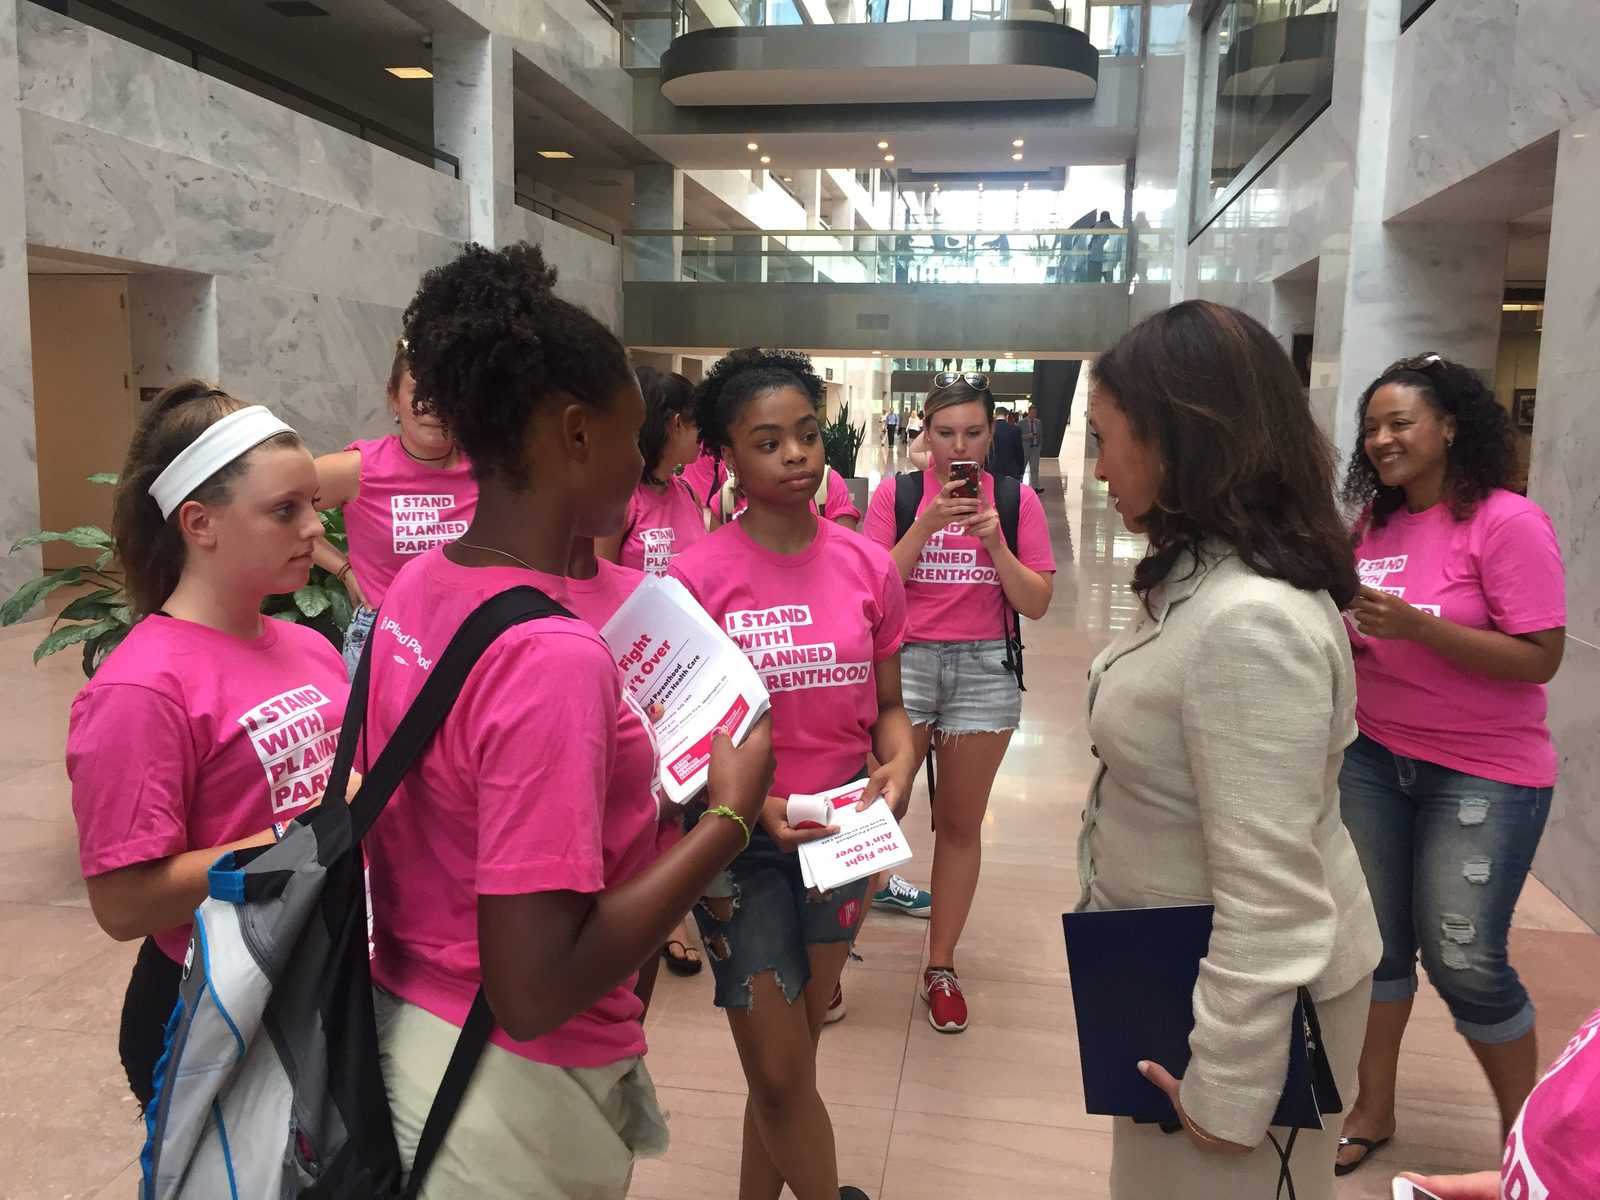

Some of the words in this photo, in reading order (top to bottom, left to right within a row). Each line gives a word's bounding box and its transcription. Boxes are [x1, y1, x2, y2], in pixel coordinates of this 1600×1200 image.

[394, 498, 399, 508] I
[403, 497, 452, 508] STAND
[396, 511, 436, 521] WITH
[396, 523, 465, 536] PLANNED
[396, 538, 456, 552] PARE
[646, 556, 671, 567] PLA
[916, 551, 974, 564] ANNED
[1365, 558, 1404, 572] STAND
[910, 568, 1000, 581] RENTHOO
[729, 616, 736, 630] I
[741, 608, 808, 628] STAND
[733, 629, 789, 650] WITH
[618, 634, 652, 672] Fight
[748, 646, 833, 670] LANNED
[628, 675, 646, 694] n't
[641, 640, 672, 675] Over
[670, 667, 690, 692] Health
[687, 654, 701, 671] Care
[652, 663, 683, 700] Parenthood
[765, 666, 868, 690] RENTHOOD
[245, 716, 259, 732] I
[259, 689, 322, 724] STAND
[258, 713, 322, 756] WITH
[269, 732, 340, 784] PLANN
[864, 831, 892, 847] Ain't
[835, 844, 863, 859] Over
[877, 842, 899, 854] The
[844, 851, 876, 868] Fight
